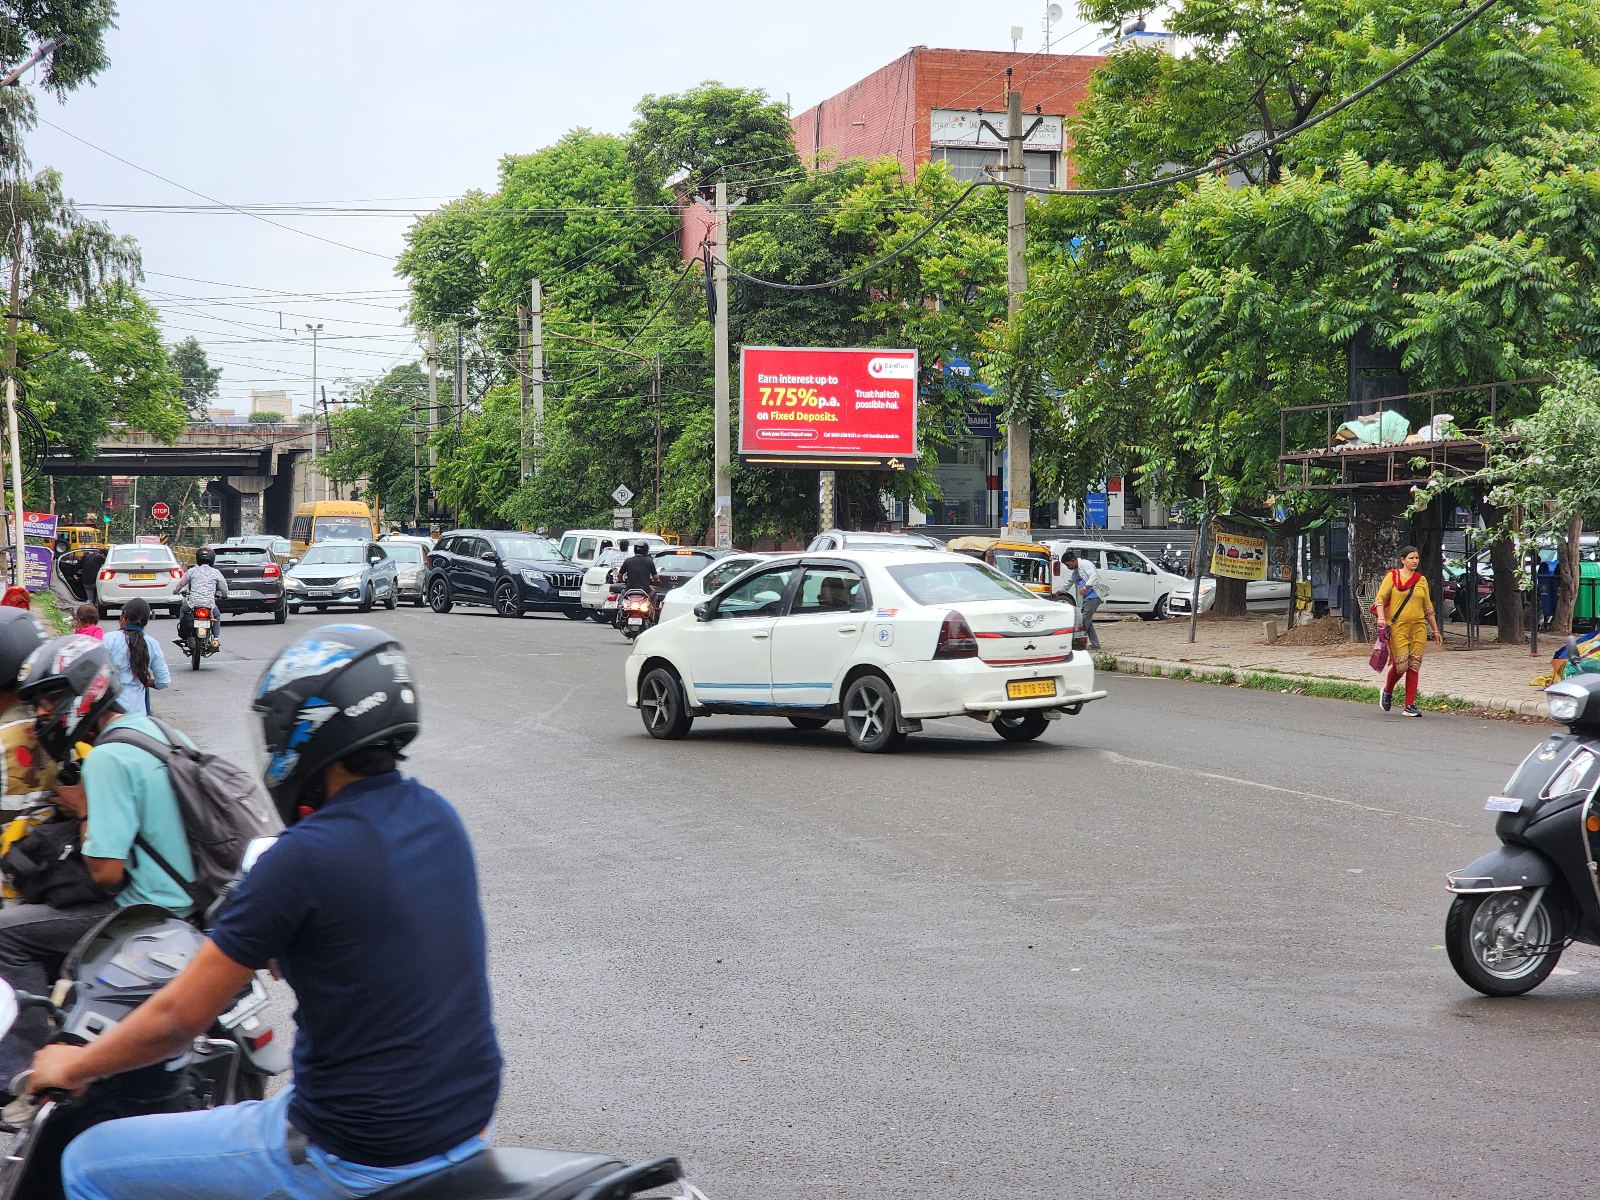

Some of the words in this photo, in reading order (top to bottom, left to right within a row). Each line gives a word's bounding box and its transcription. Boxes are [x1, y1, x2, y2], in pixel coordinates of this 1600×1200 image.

[758, 374, 777, 384] Earn
[779, 374, 814, 385] interest
[815, 376, 827, 386] up
[828, 376, 838, 385] to
[855, 389, 874, 398] Trust
[874, 389, 886, 398] hai
[886, 390, 900, 399] toh
[818, 396, 840, 409] p.a.
[855, 400, 885, 410] possible
[885, 401, 899, 410] hai.
[757, 412, 769, 421] on
[770, 411, 795, 421] Fixed
[796, 411, 839, 423] Deposits.
[968, 416, 989, 425] BANK
